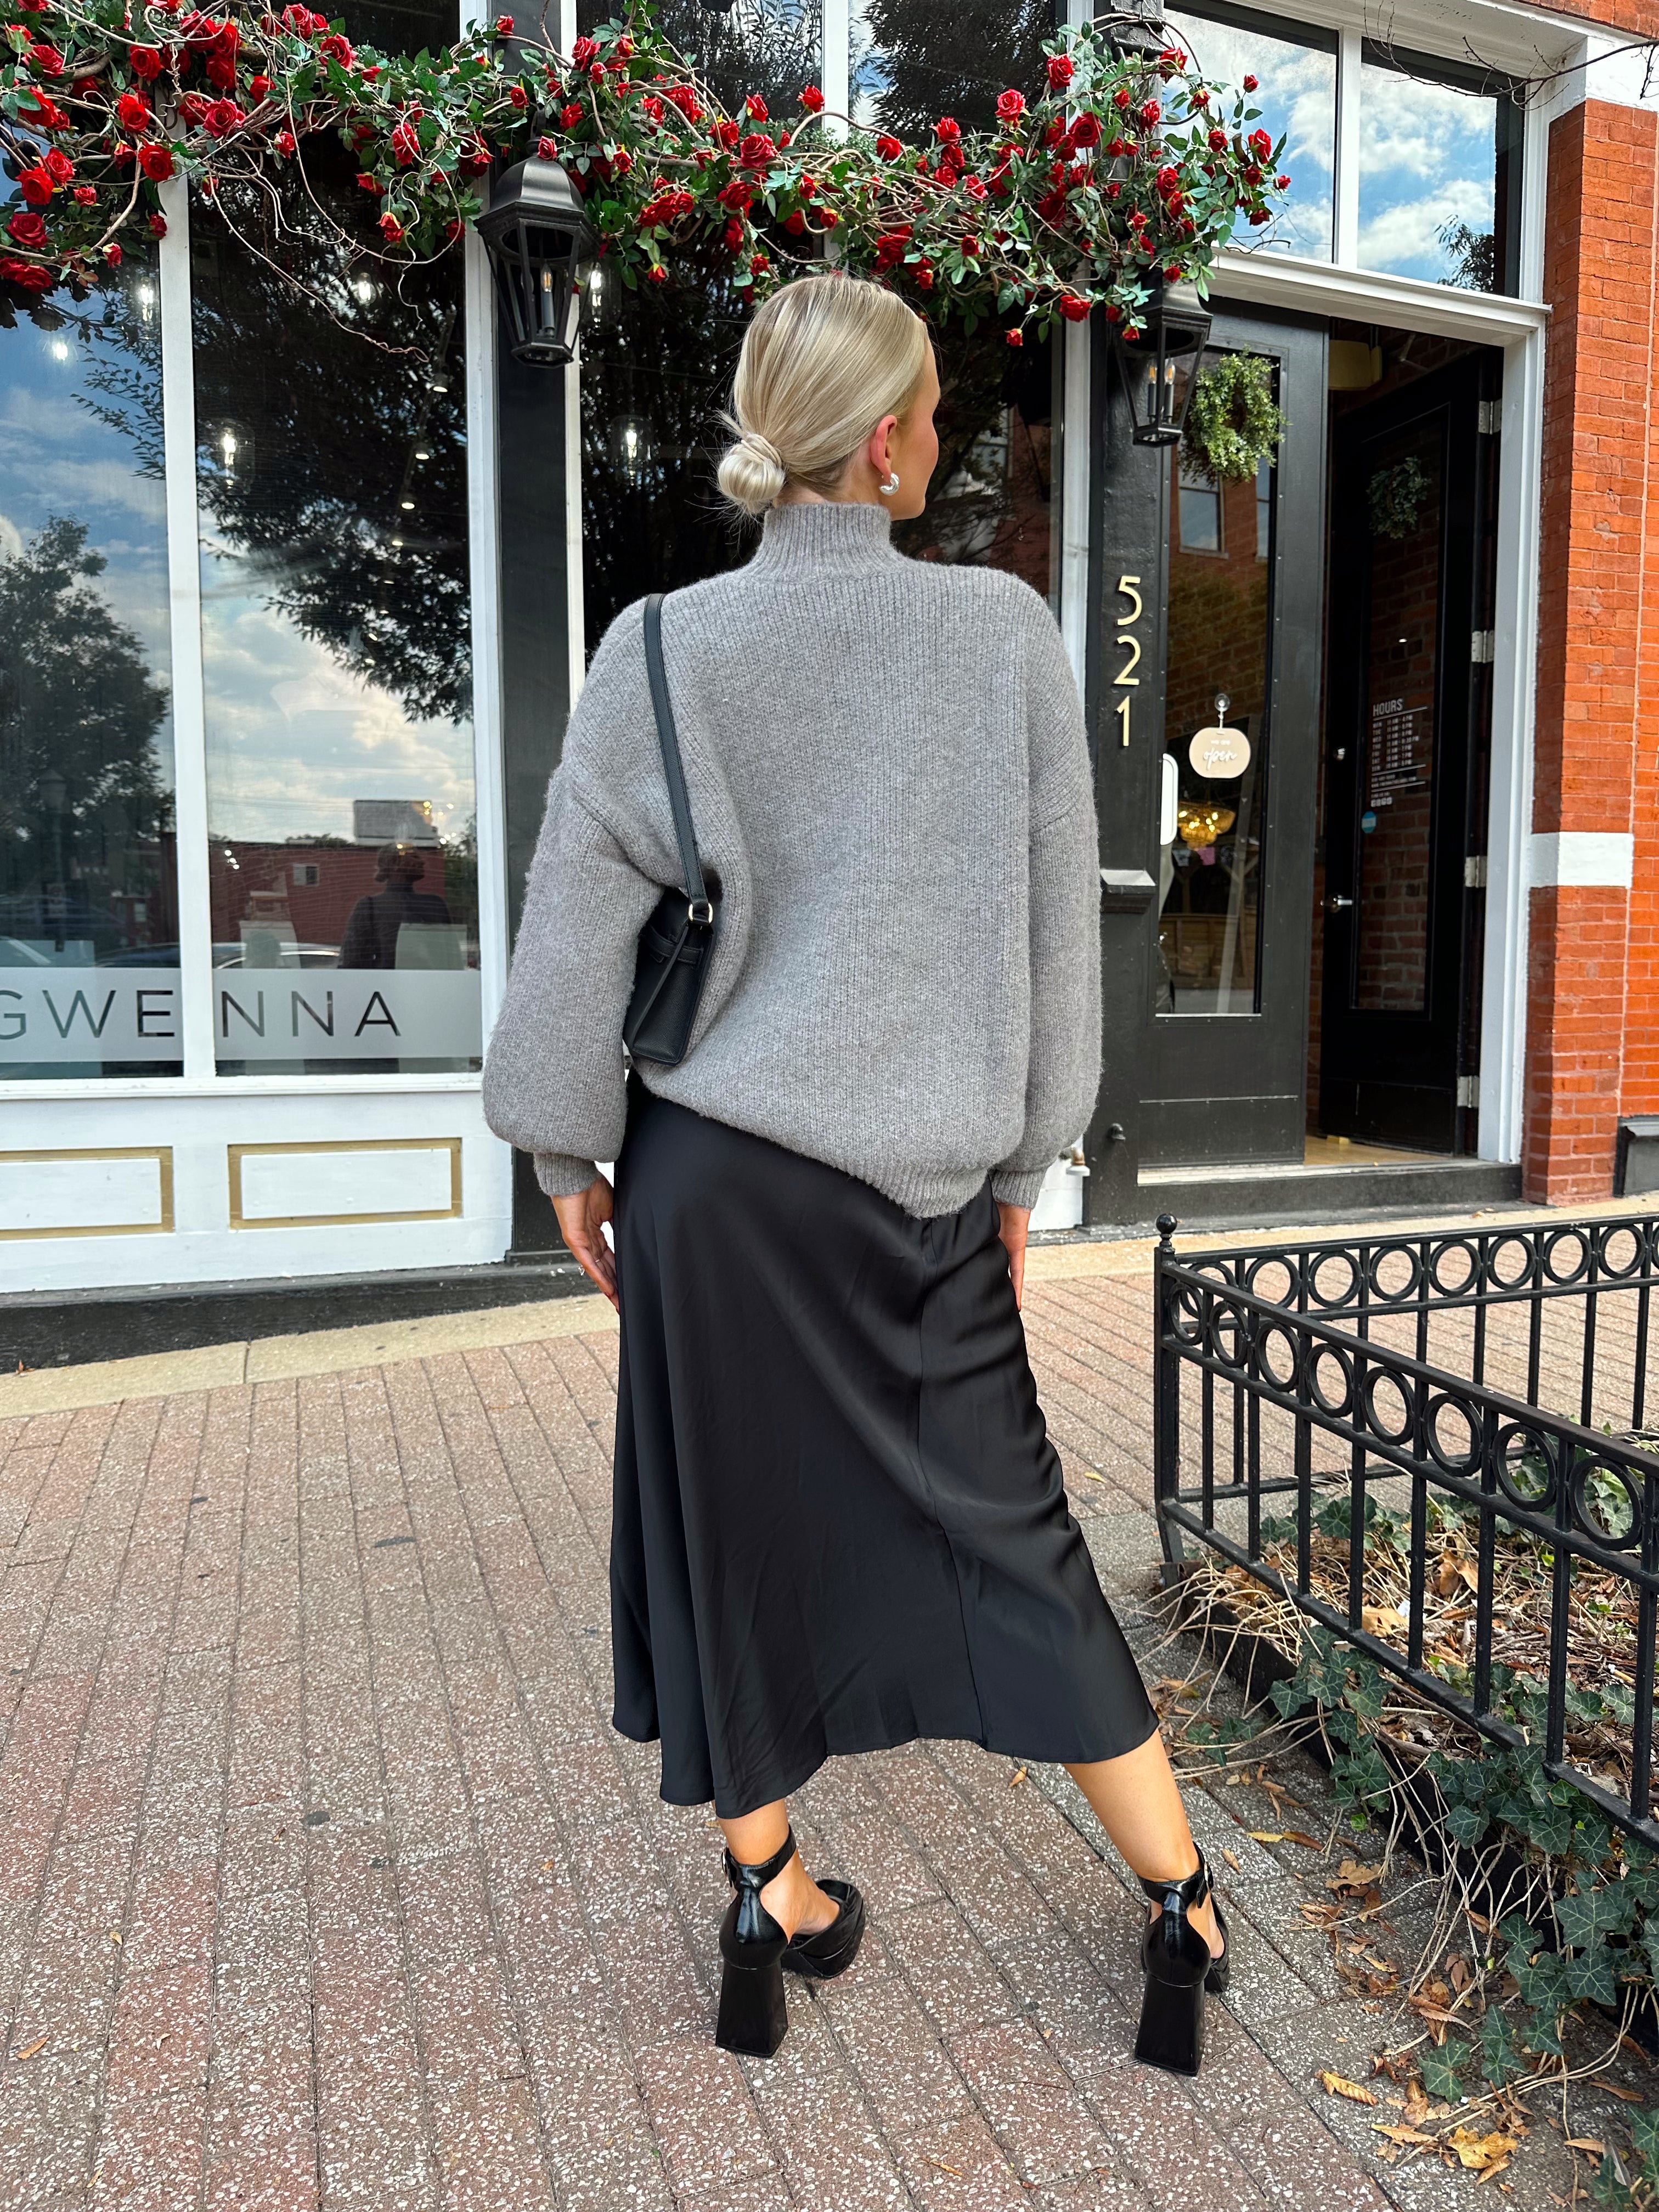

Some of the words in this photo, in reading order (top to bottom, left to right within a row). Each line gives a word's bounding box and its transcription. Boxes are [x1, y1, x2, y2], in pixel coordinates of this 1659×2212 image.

[1114, 575, 1143, 747] 521
[1373, 698, 1403, 716] HOURS
[1203, 747, 1238, 770] open
